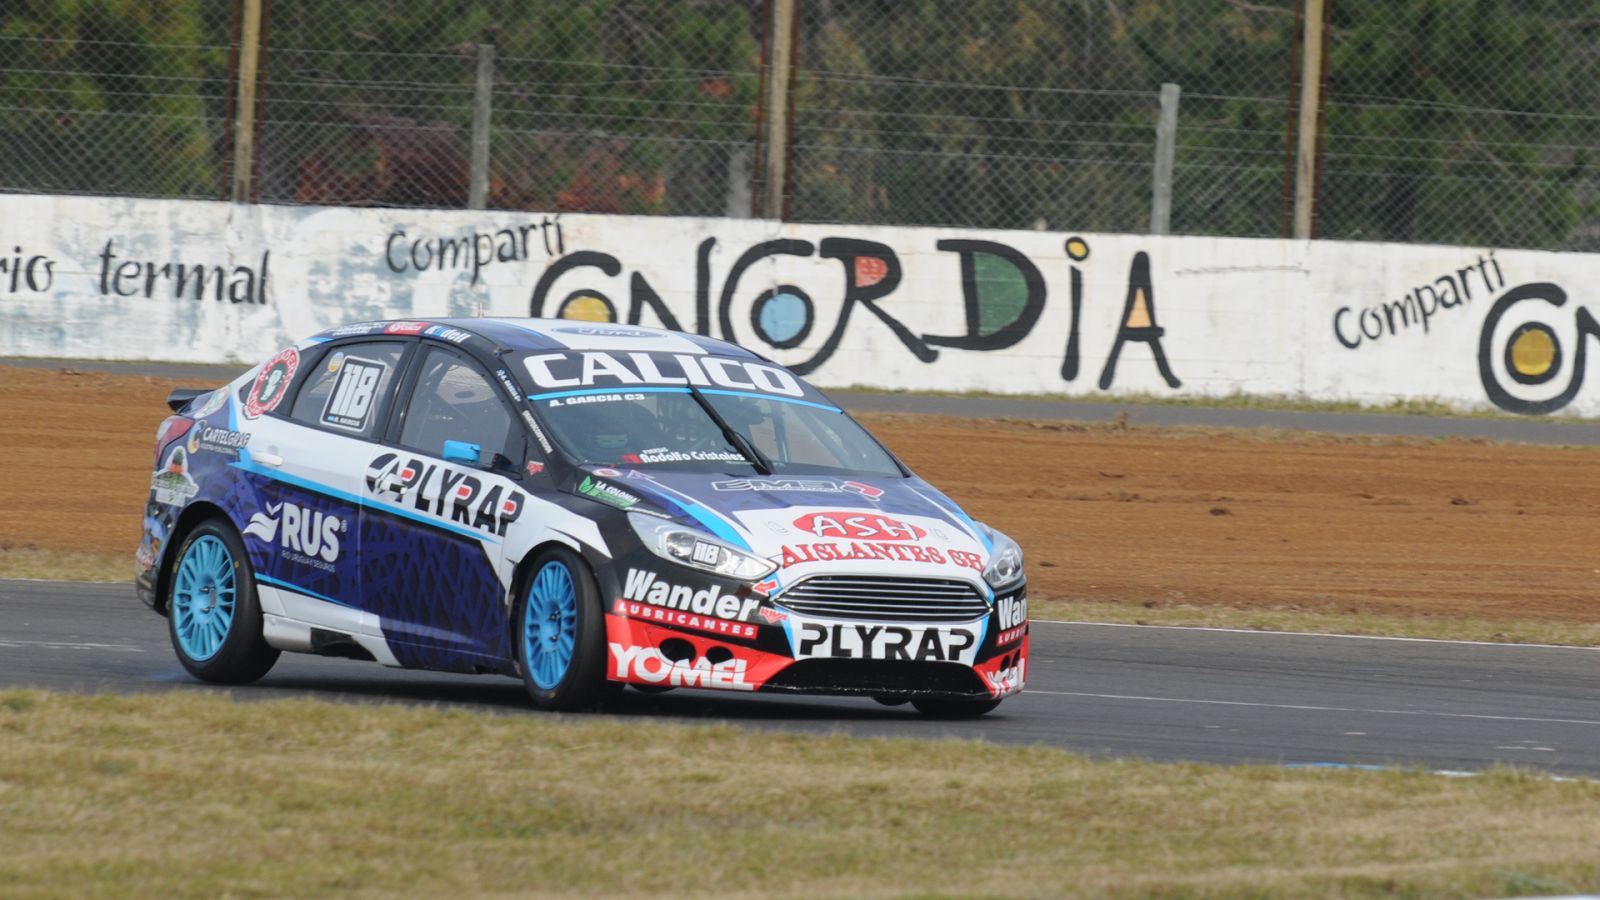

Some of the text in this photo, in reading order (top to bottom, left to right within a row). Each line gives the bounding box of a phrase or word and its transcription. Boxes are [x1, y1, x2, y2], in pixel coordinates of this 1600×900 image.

[99, 238, 269, 305] termal
[329, 363, 380, 419] 118
[523, 351, 804, 397] CALICO
[548, 393, 645, 407] A. GARCIA C3
[640, 451, 691, 463] Rodolfo
[395, 459, 525, 538] PLYRAP
[812, 515, 919, 541] ASH
[693, 541, 720, 565] 118
[781, 542, 946, 569] AISLANTES
[624, 568, 760, 621] Wander
[618, 602, 754, 636] LUBRICANTES
[799, 622, 975, 661] PLYRAP
[609, 642, 754, 691] YOMEL
